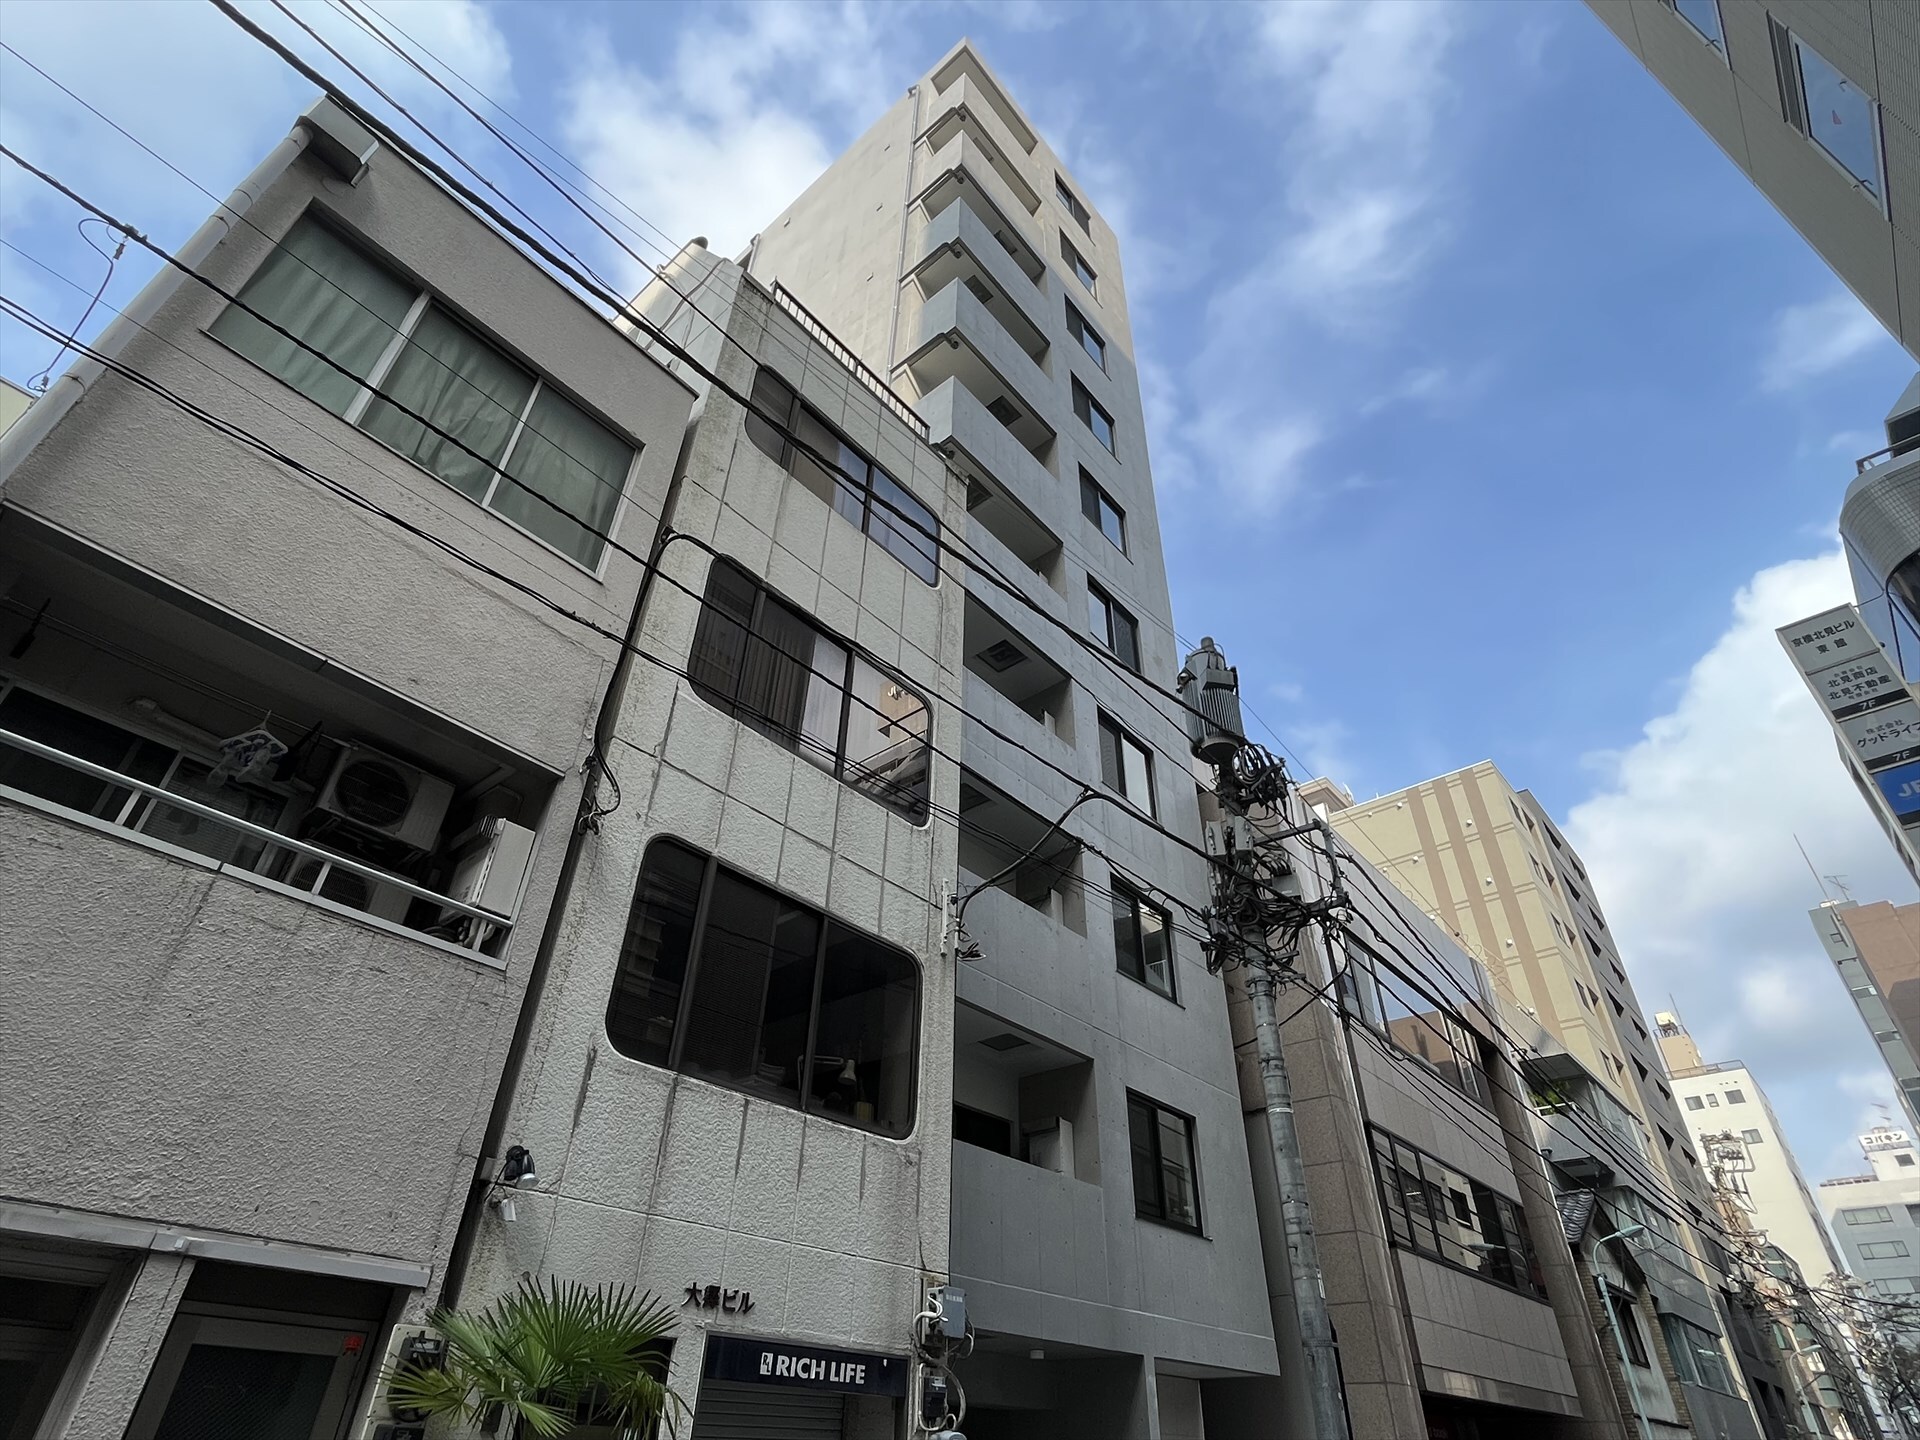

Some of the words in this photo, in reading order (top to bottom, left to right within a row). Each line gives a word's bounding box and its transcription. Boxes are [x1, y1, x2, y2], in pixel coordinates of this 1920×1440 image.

[1791, 620, 1855, 647] 京橋北見ビル
[1859, 700, 1876, 710] 7F
[1893, 750, 1910, 761] 7F
[776, 1355, 826, 1380] RICH
[829, 1361, 866, 1384] LIFE
